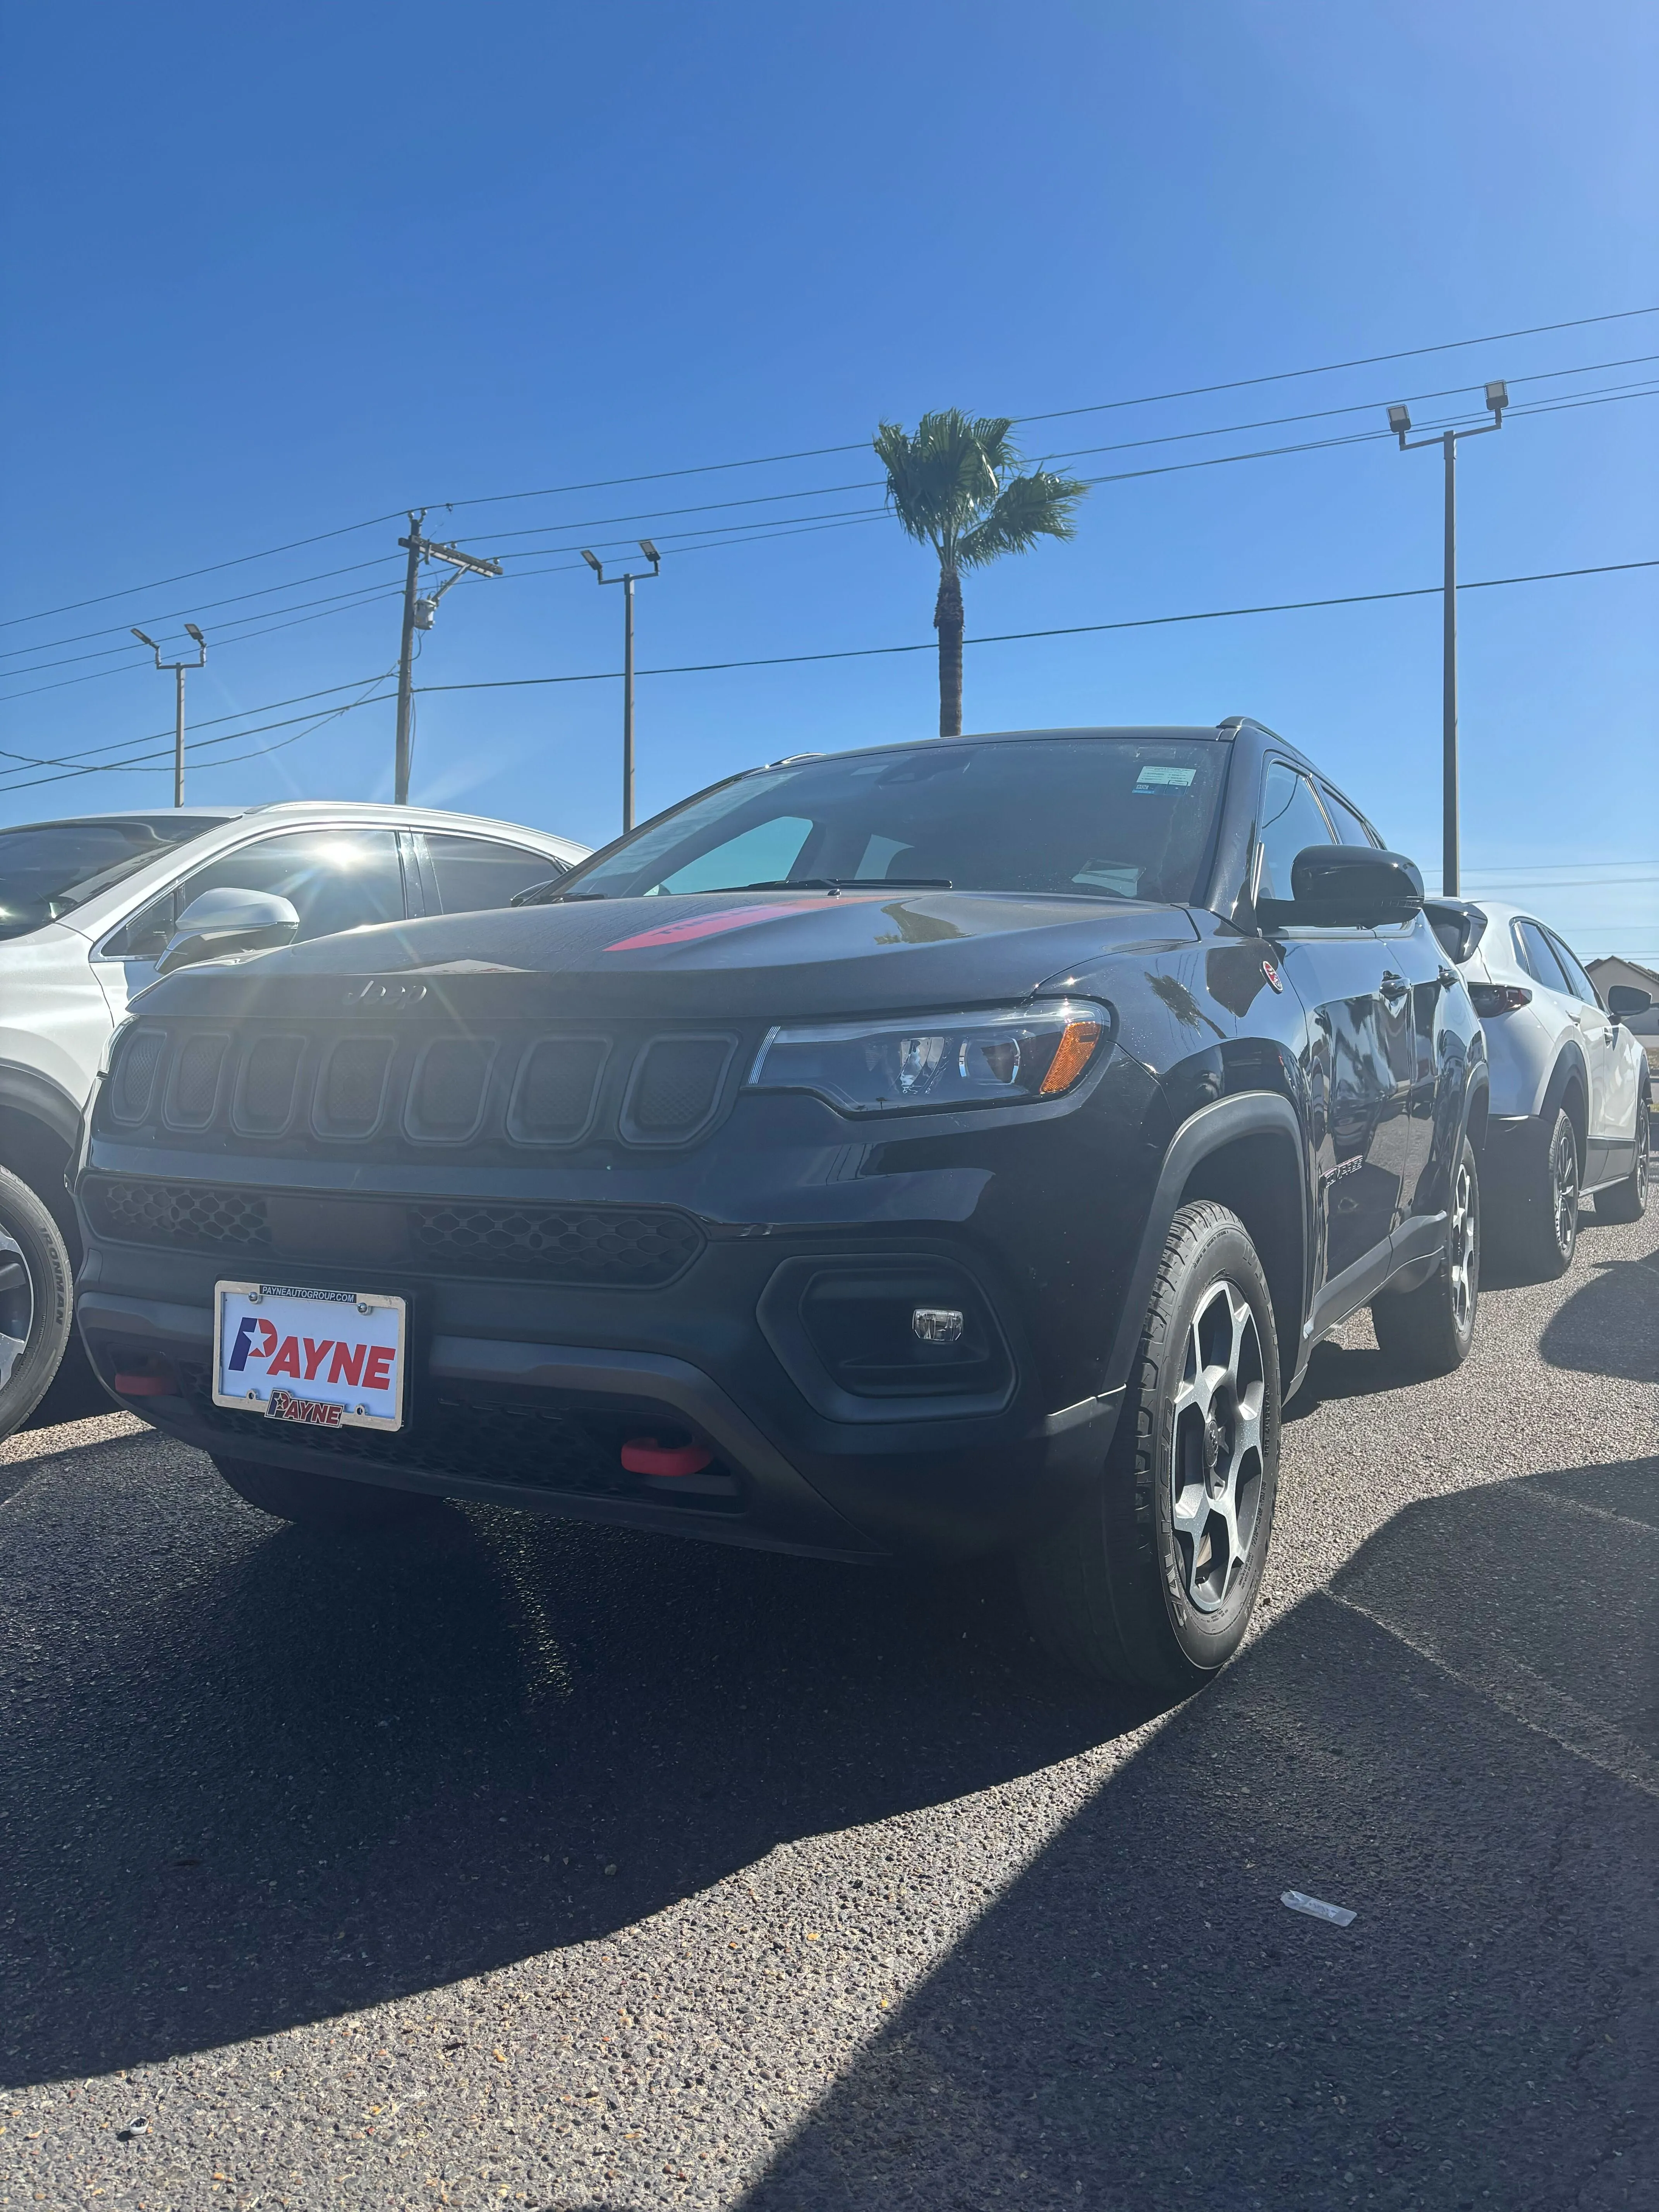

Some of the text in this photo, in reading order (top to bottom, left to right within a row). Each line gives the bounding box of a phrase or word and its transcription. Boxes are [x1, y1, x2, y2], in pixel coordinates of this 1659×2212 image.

[342, 980, 427, 1010] Jeep
[39, 1227, 65, 1325] IRONMAN
[262, 1286, 354, 1303] PAYNEAUTOGROUP.COM
[228, 1317, 396, 1390] PAYNE
[268, 1391, 342, 1425] PAYNE
[1160, 1397, 1187, 1630] FALKEN
